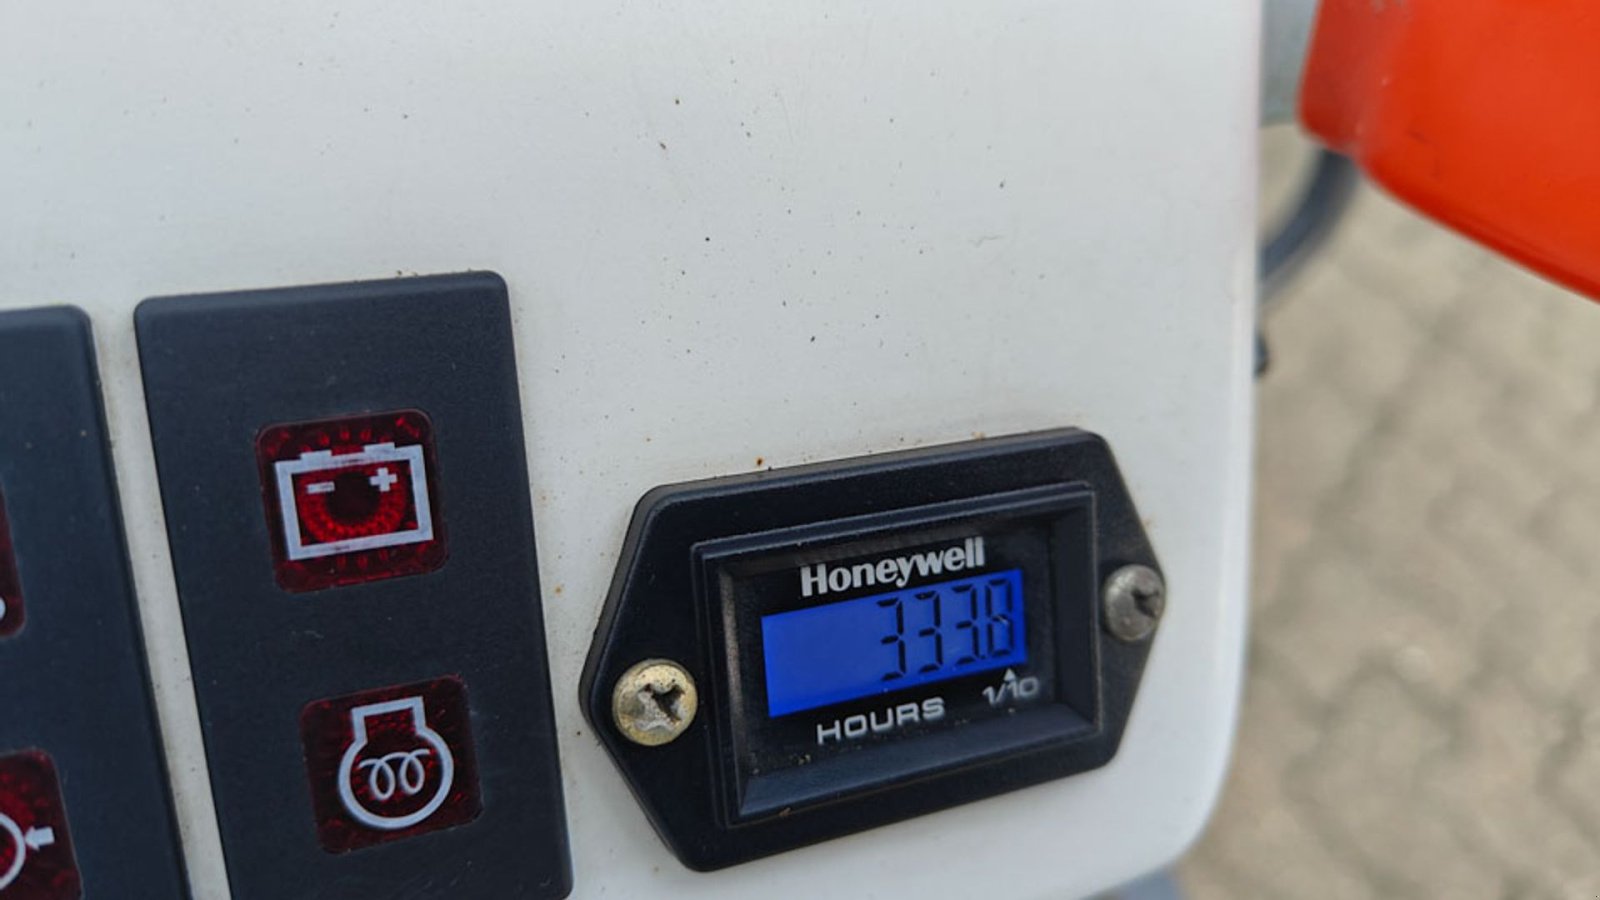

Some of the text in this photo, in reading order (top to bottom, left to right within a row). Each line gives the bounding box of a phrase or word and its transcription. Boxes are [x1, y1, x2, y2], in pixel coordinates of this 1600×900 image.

[801, 536, 985, 597] Honeywell
[876, 578, 1014, 682] 333.8
[982, 676, 1039, 706] 1/10
[816, 696, 945, 745] HOURS
